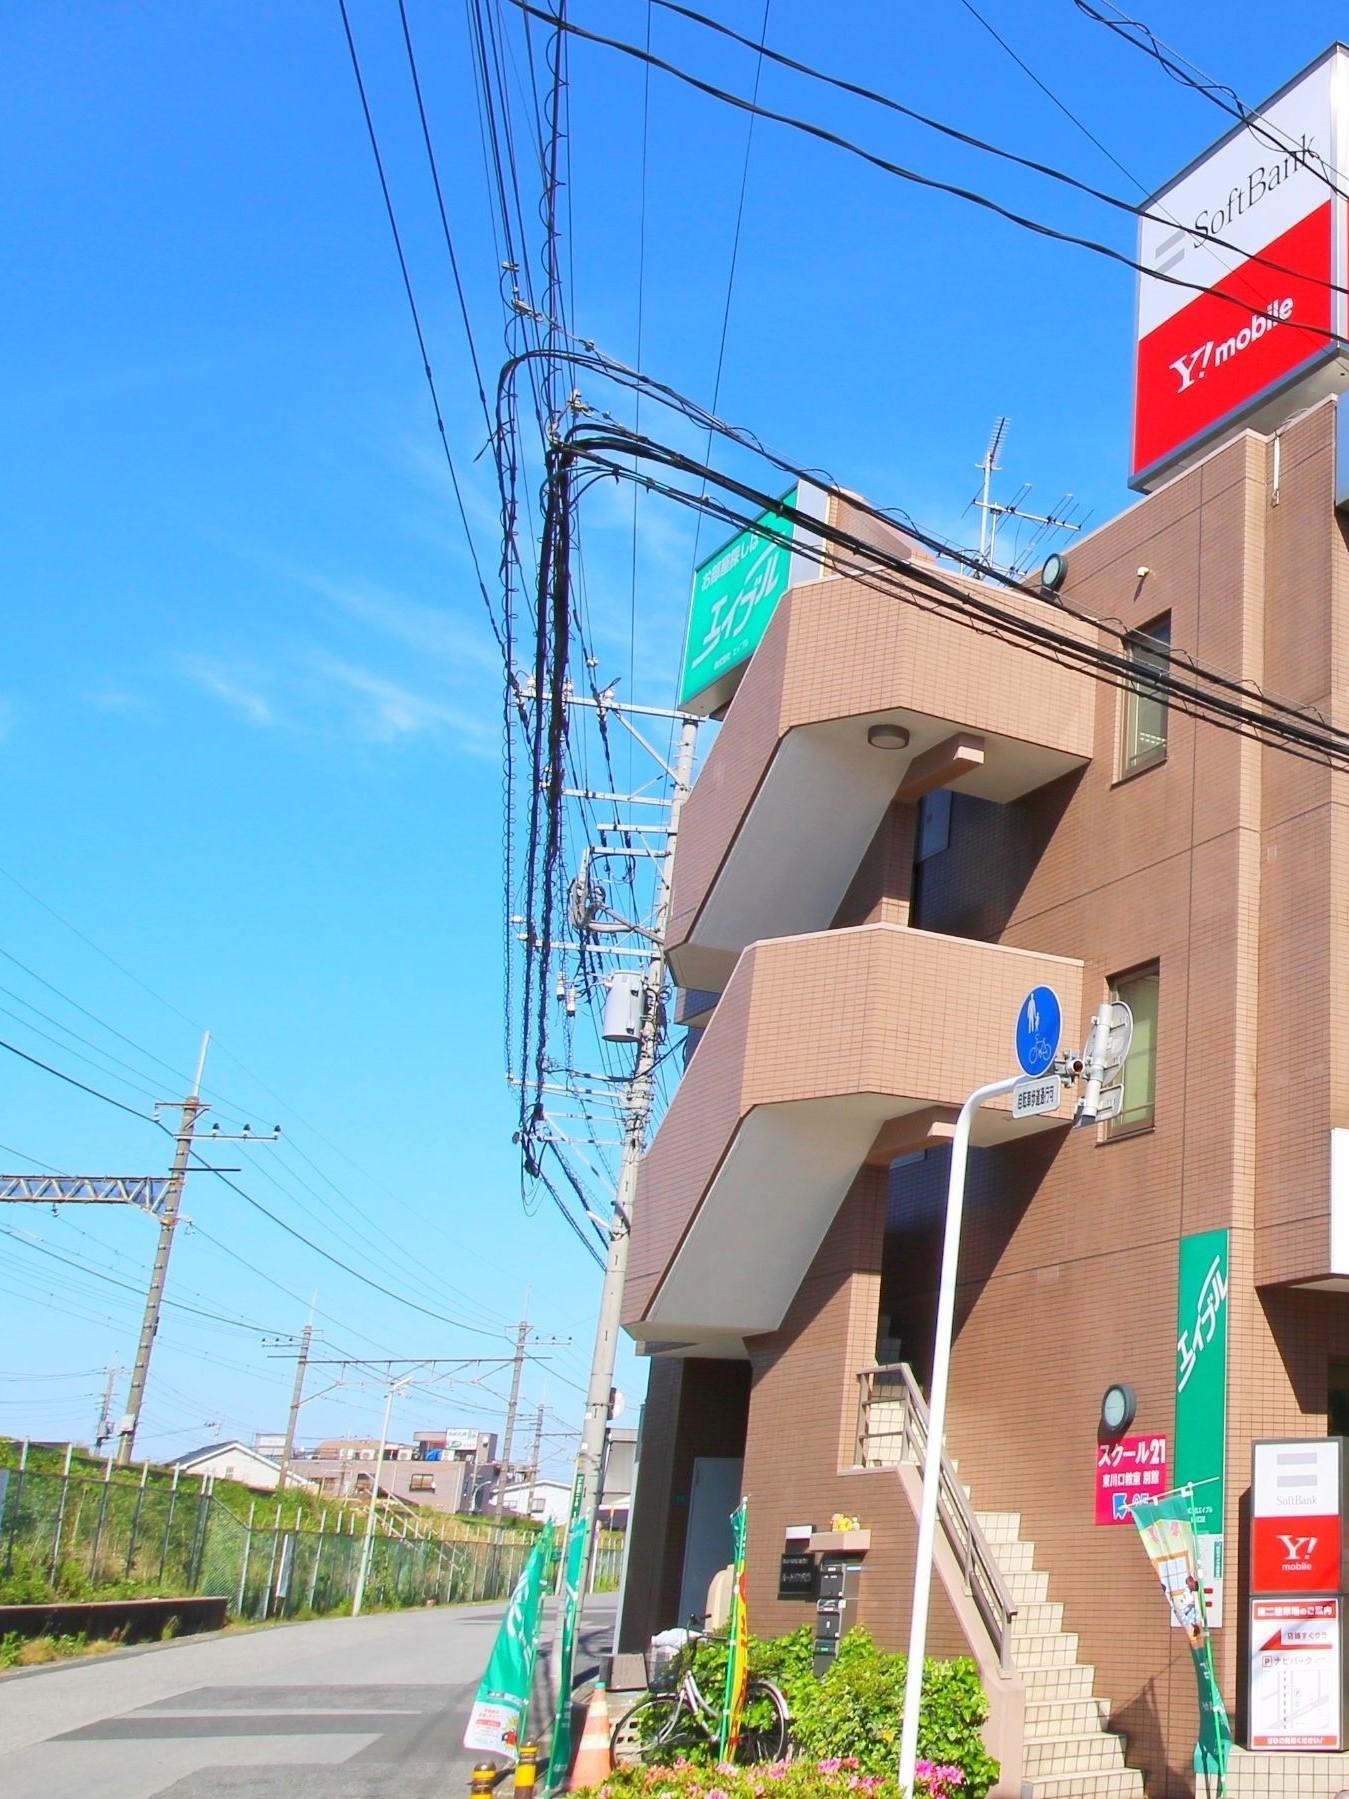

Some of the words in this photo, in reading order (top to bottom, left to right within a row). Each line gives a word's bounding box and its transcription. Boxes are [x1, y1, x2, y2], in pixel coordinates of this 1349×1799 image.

[1194, 134, 1317, 249] SoftBank
[691, 532, 787, 670] エイブル
[1177, 1255, 1229, 1393] エイブル
[1097, 1439, 1167, 1468] スクール21
[1276, 1495, 1318, 1507] SoftBank
[1276, 1534, 1318, 1561] Y!
[1281, 1562, 1313, 1572] mobile
